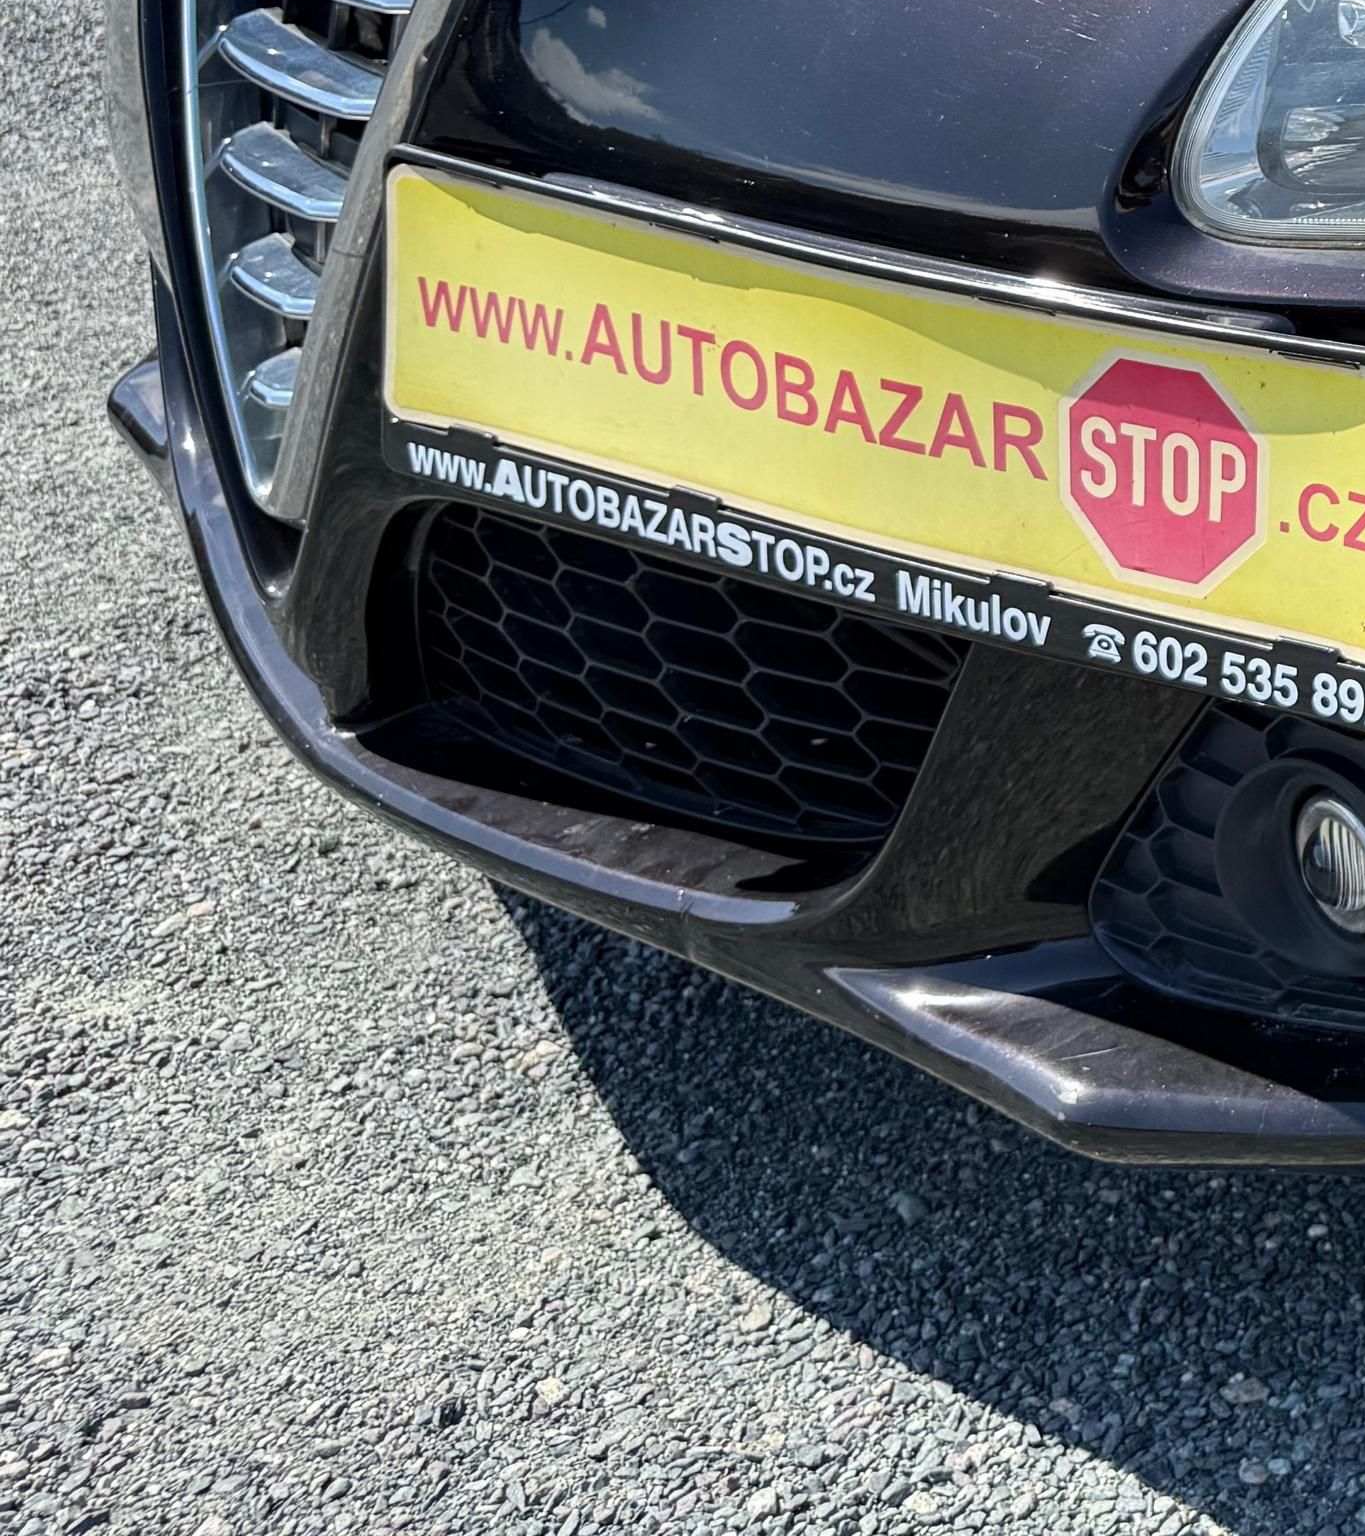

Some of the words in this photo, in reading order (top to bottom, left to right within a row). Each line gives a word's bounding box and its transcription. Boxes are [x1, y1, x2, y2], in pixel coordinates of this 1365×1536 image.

[1080, 416, 1247, 524] STOP
[897, 570, 1051, 647] Mikulov
[1133, 631, 1208, 687] 602
[1221, 654, 1299, 708] 535
